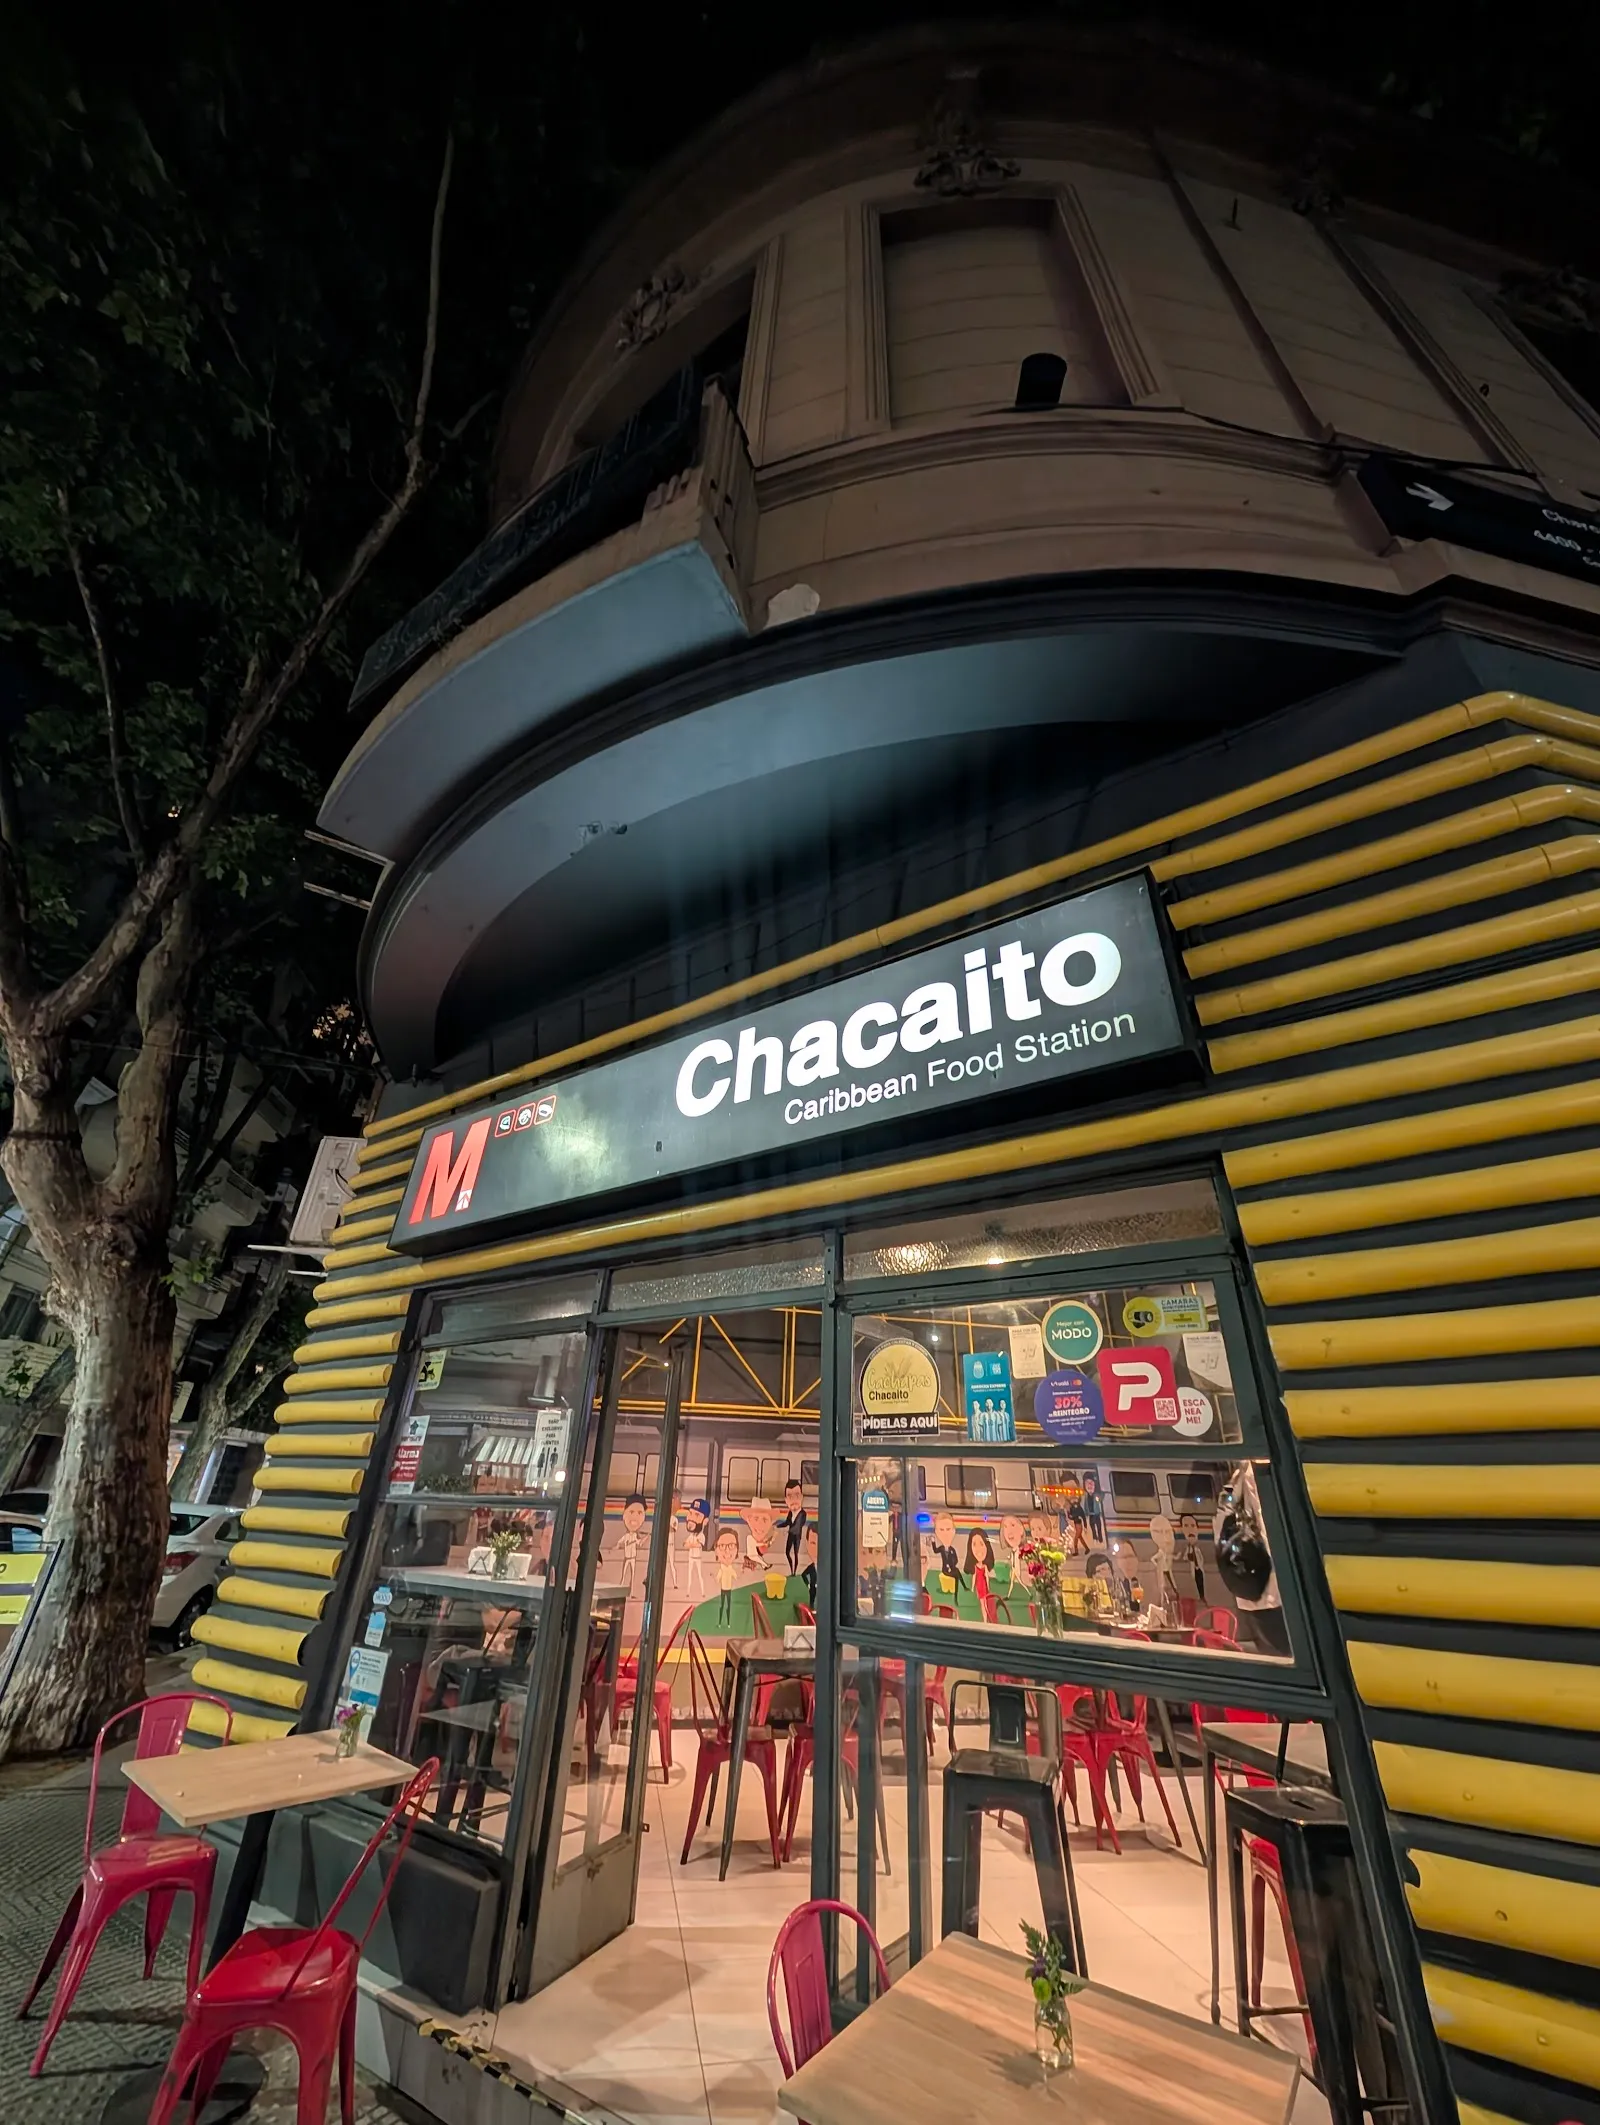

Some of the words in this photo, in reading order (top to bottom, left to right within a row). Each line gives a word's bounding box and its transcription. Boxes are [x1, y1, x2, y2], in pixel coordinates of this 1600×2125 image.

[675, 931, 1122, 1118] Chacaito
[783, 1072, 919, 1126] Caribbean
[927, 1042, 1003, 1090] Food
[1013, 1013, 1136, 1063] Station
[409, 1117, 492, 1225] M
[1051, 1327, 1092, 1341] MODO
[866, 1367, 932, 1392] Cachapas
[868, 1390, 909, 1401] Chacaito
[1182, 1398, 1206, 1407] ESCA
[1052, 1407, 1090, 1417] REINTEGRO
[1184, 1407, 1202, 1416] NEA
[863, 1416, 908, 1430] PÍDELAS
[909, 1414, 938, 1428] AQUÍ
